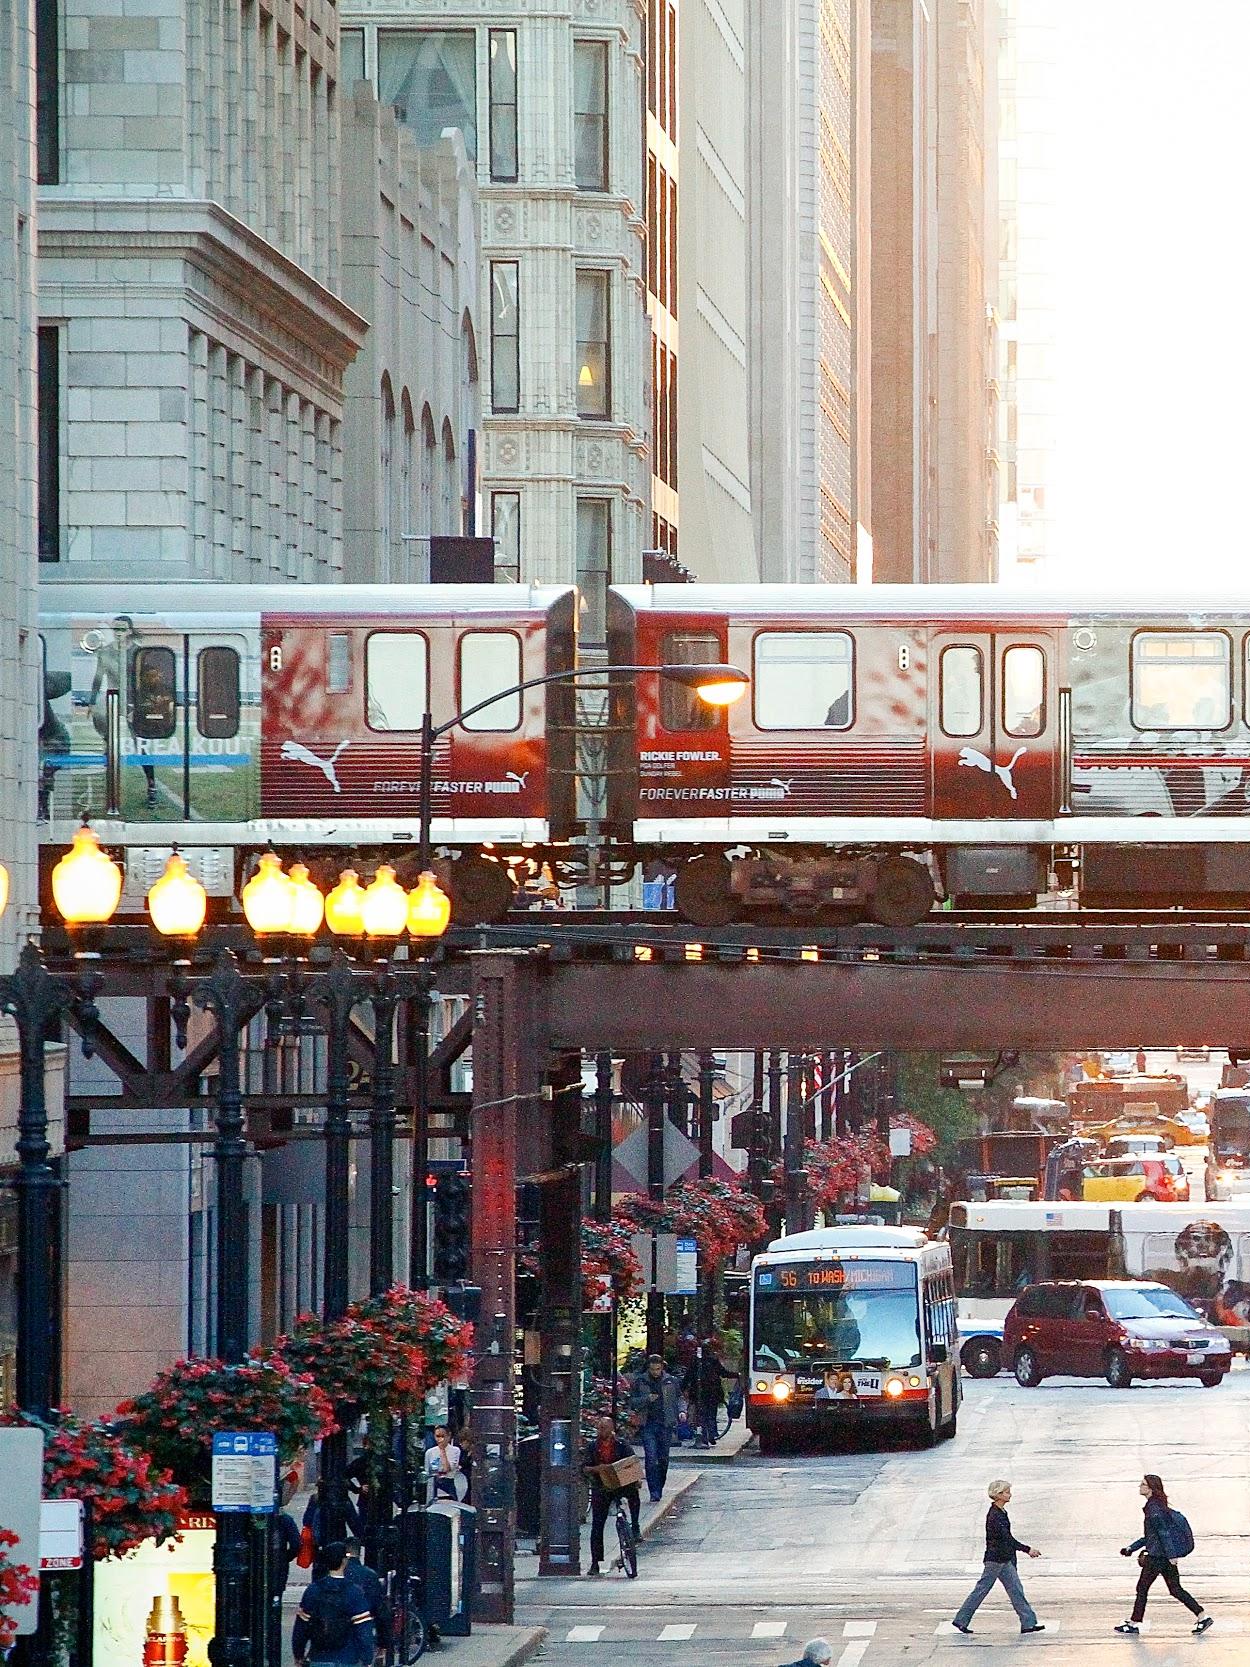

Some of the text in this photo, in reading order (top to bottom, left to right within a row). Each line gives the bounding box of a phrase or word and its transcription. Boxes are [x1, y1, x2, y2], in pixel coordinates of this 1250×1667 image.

[640, 751, 675, 761] RICKIE
[780, 1270, 797, 1287] 56
[45, 1558, 74, 1568] ZONE
